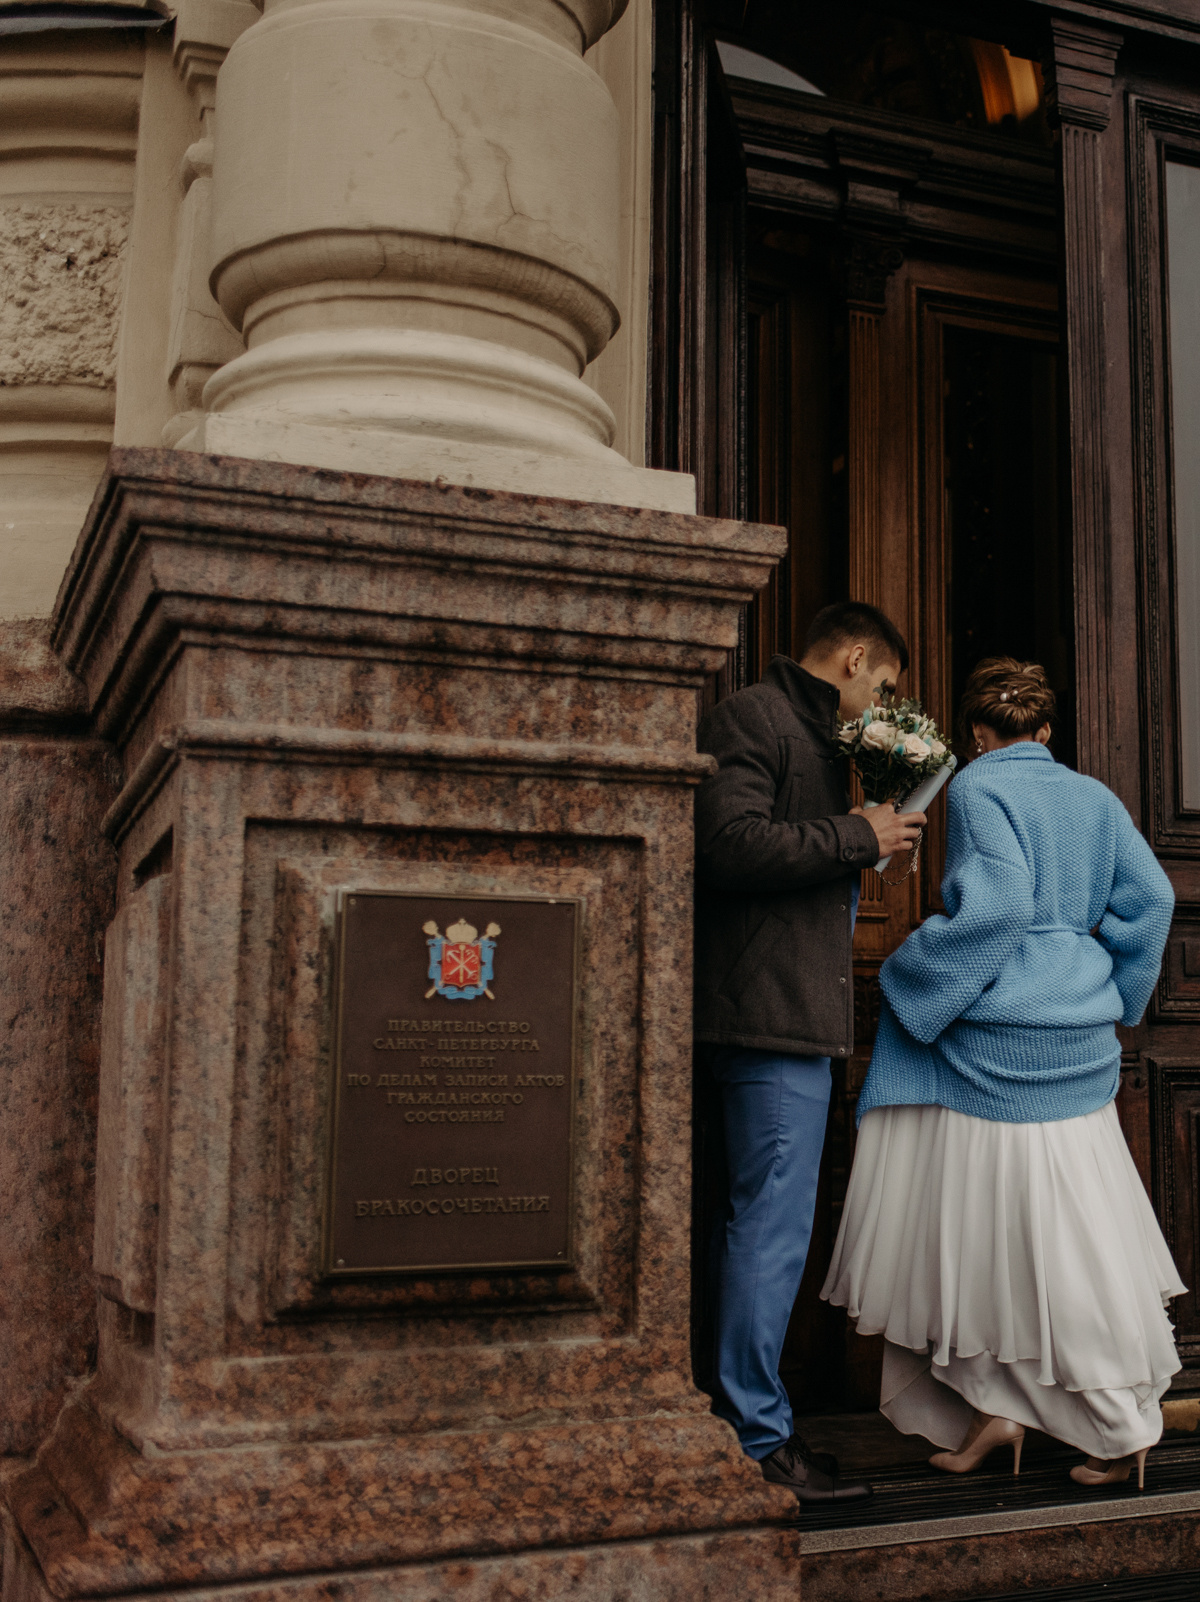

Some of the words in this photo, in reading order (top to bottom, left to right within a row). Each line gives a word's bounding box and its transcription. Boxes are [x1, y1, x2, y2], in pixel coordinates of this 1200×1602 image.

[387, 1019, 531, 1034] ПРАВИТЕЛЬСТВО
[373, 1038, 540, 1051] САНКТ-ПЕТЕРБУРГА
[419, 1056, 496, 1069] КОМИТЕТ
[348, 1074, 372, 1087] ПО
[376, 1074, 438, 1088] ДЕЛАМ
[445, 1074, 508, 1087] ЗАПИСИ
[514, 1074, 566, 1087] АКТОВ
[386, 1092, 524, 1106] ГРАЖДАНСКОГО
[405, 1110, 505, 1123] СОСТОЯНИЯ
[410, 1167, 500, 1187] ДВОРЕЦ
[355, 1196, 551, 1217] БРАКОСОЧЕТАНИЯ
